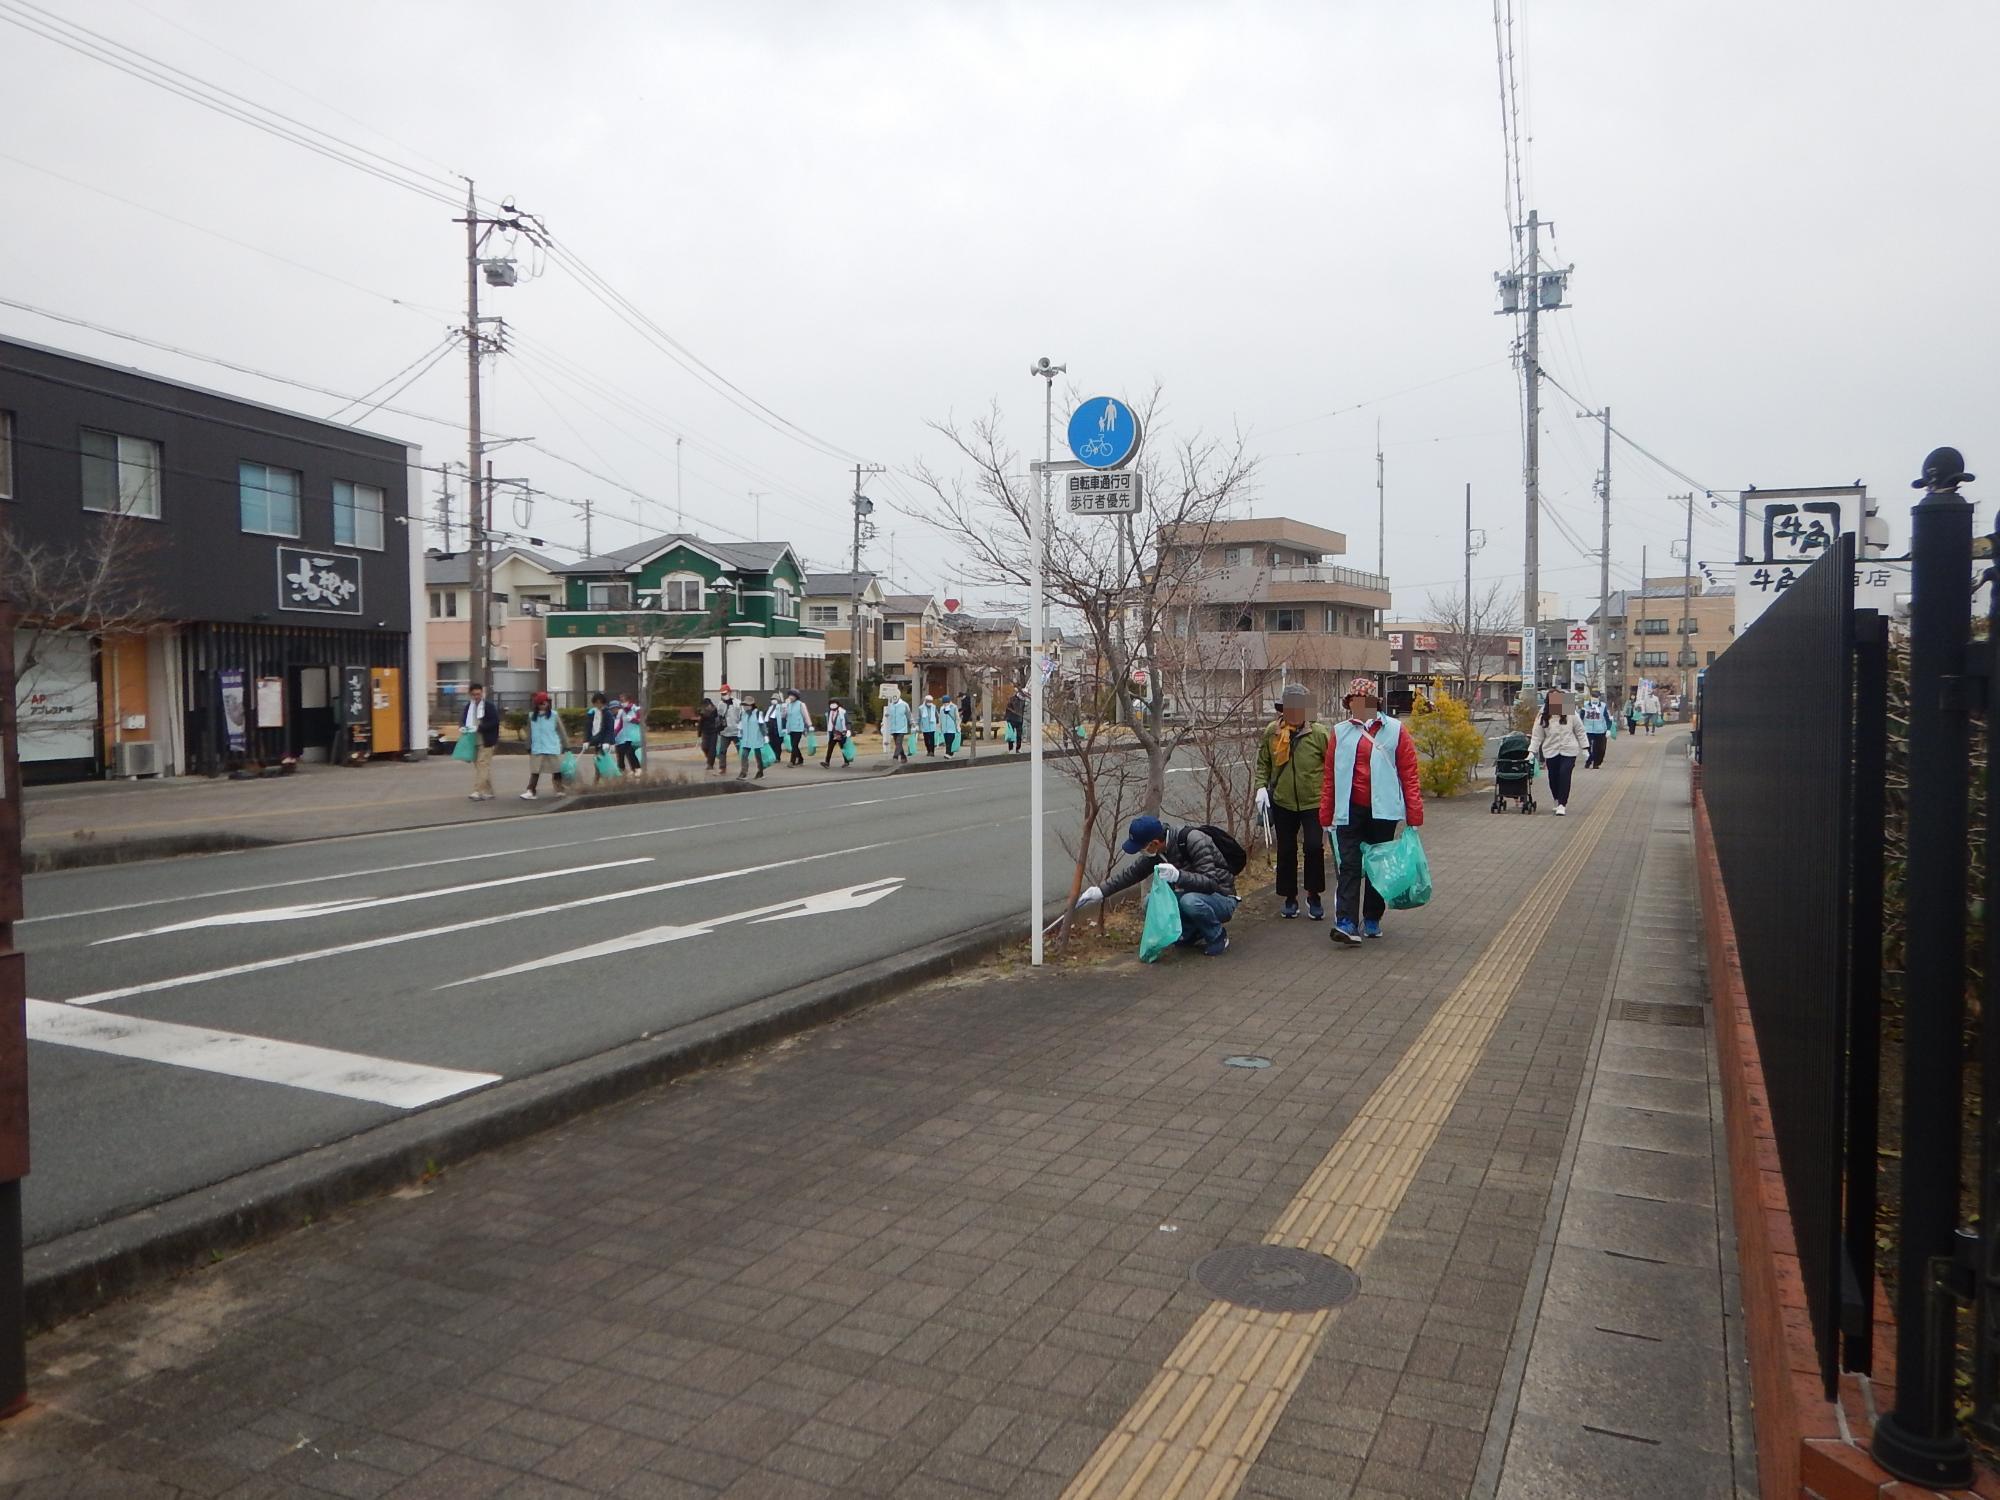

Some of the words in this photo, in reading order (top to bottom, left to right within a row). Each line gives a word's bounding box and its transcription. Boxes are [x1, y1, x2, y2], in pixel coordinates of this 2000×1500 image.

[1070, 474, 1130, 491] 自転車通行可
[1070, 493, 1130, 511] 歩行者優先
[1774, 515, 1831, 553] 牛角
[1570, 627, 1587, 643] 本
